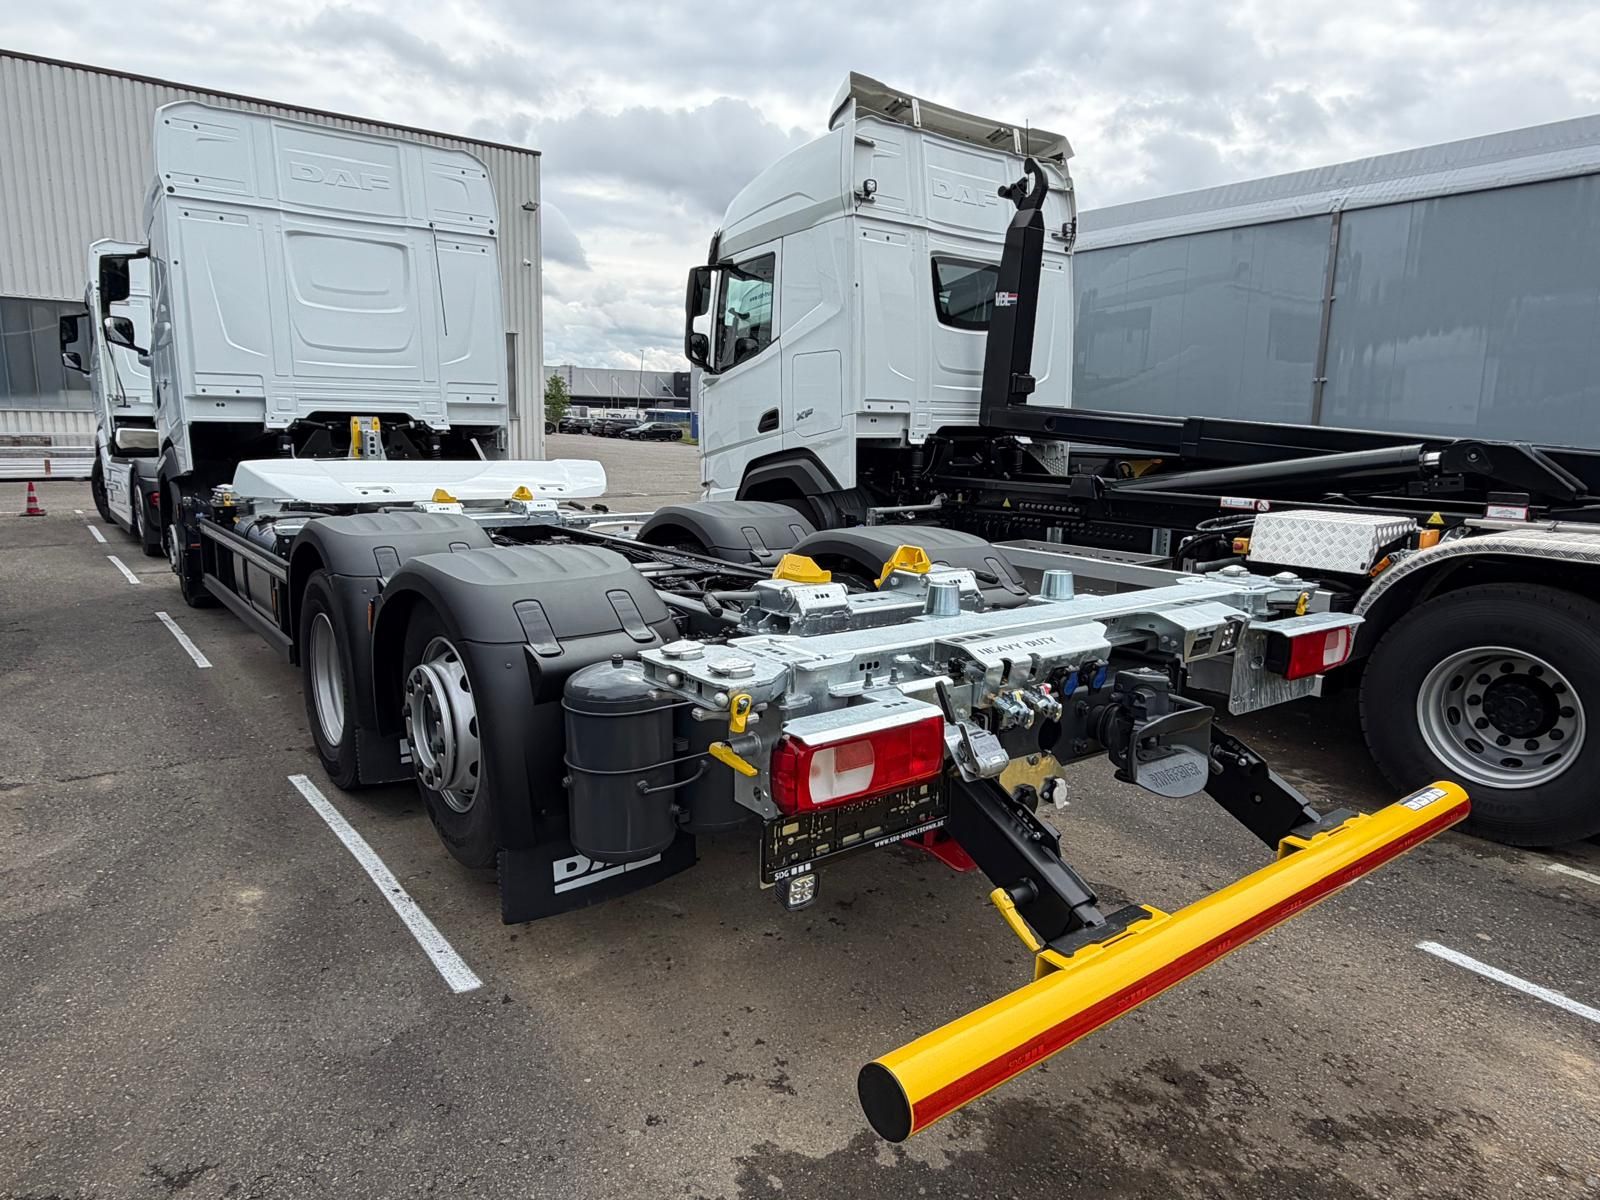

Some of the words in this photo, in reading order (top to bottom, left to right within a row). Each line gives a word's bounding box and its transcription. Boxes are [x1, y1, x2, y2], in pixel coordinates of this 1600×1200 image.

[289, 161, 391, 191] DAF
[931, 179, 998, 208] DAF
[995, 291, 1011, 307] VDL
[796, 407, 814, 421] XF
[976, 642, 1023, 656] HEAVY
[1023, 636, 1057, 648] DUTY
[1148, 761, 1202, 788] RINGFEDER
[774, 869, 790, 881] SDG
